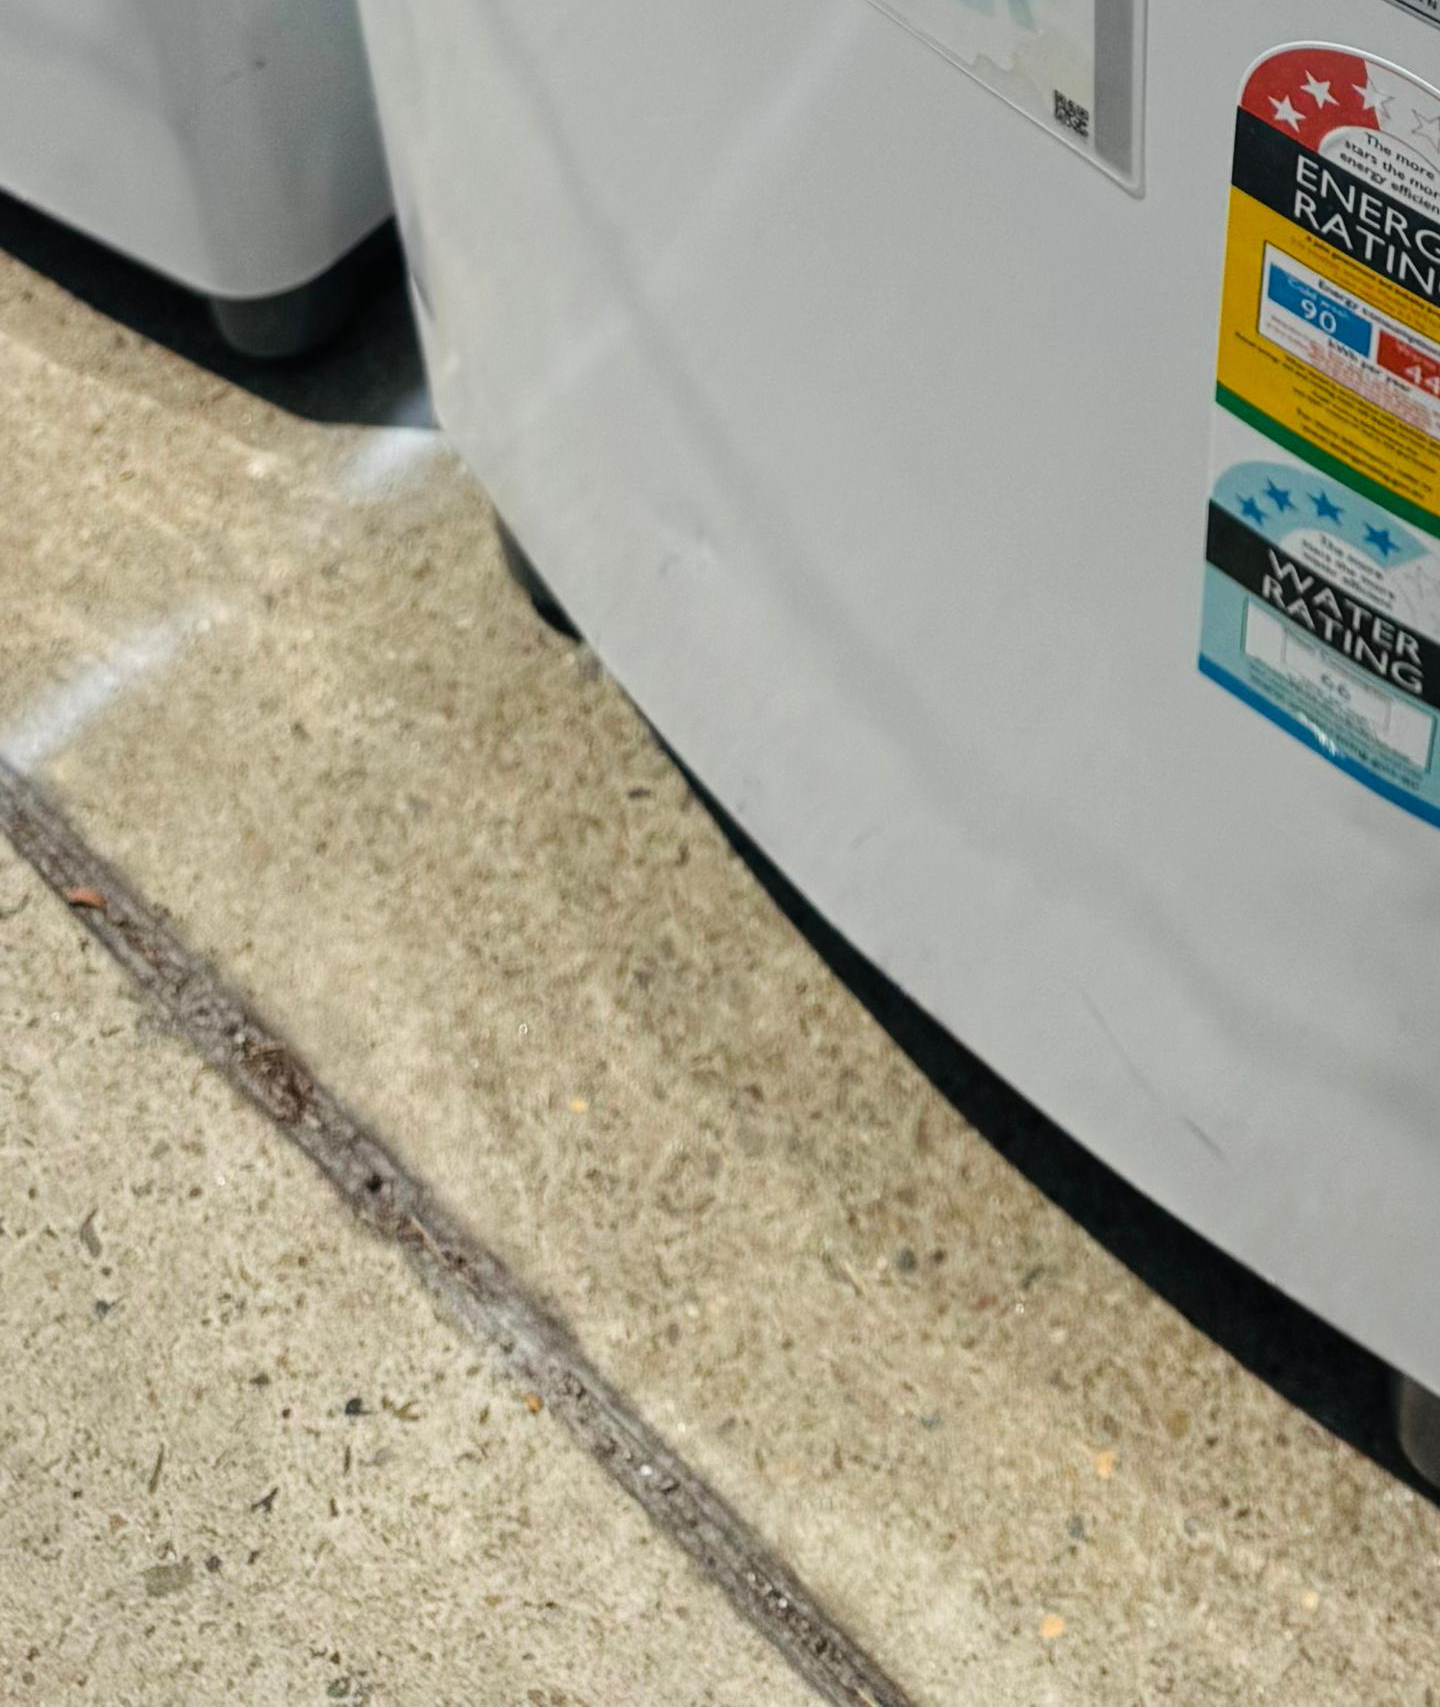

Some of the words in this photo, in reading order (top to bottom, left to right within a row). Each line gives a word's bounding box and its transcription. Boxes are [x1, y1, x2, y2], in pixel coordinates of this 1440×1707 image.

[1338, 151, 1388, 188] energy
[1343, 139, 1379, 169] stars
[1381, 161, 1407, 184] the
[1363, 131, 1393, 157] The
[1394, 152, 1436, 181] more
[1300, 298, 1338, 335] 90
[1267, 547, 1424, 667] WATER
[1261, 573, 1424, 697] RATING
